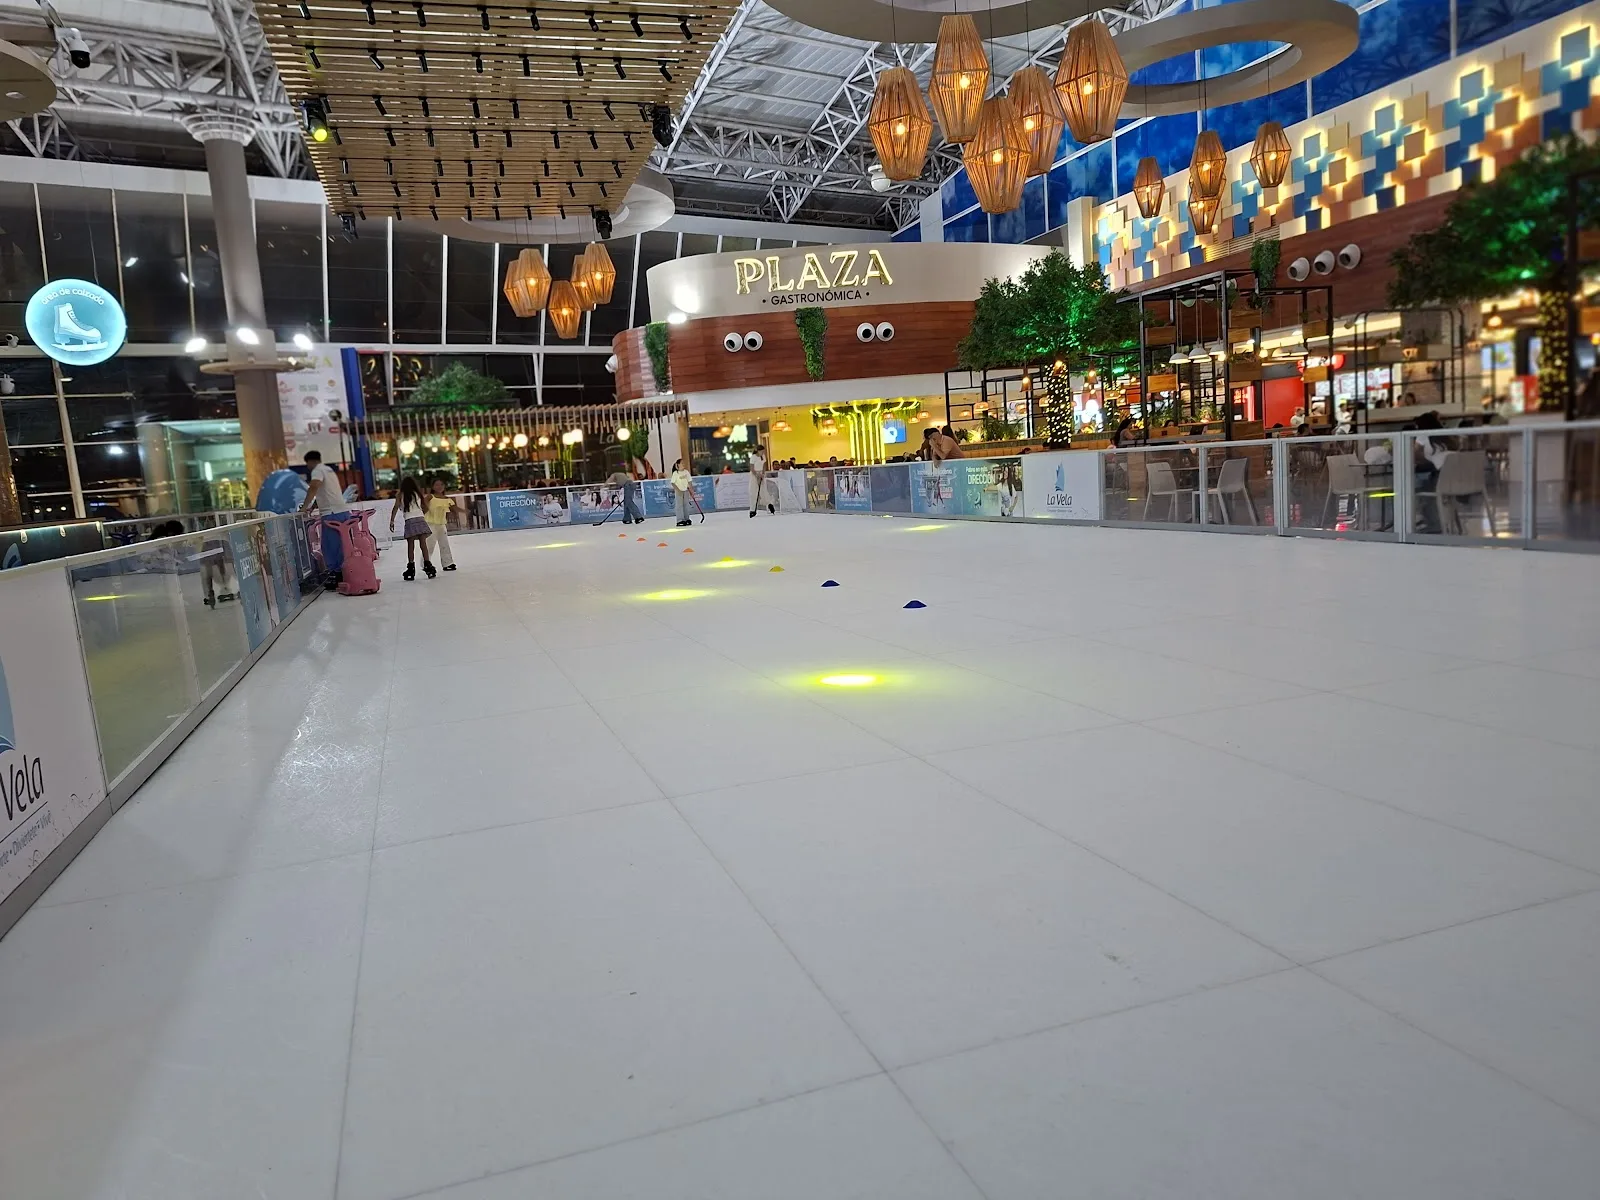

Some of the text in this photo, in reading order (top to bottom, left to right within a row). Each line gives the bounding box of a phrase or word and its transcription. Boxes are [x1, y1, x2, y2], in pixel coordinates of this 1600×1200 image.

[733, 249, 893, 295] PLAZA
[59, 288, 71, 296] de
[71, 288, 105, 306] calzado
[770, 290, 862, 306] GASTRONÓMICA
[499, 497, 536, 509] DIRECCIÓN
[1046, 493, 1073, 506] La Vela
[0, 754, 44, 821] Vela
